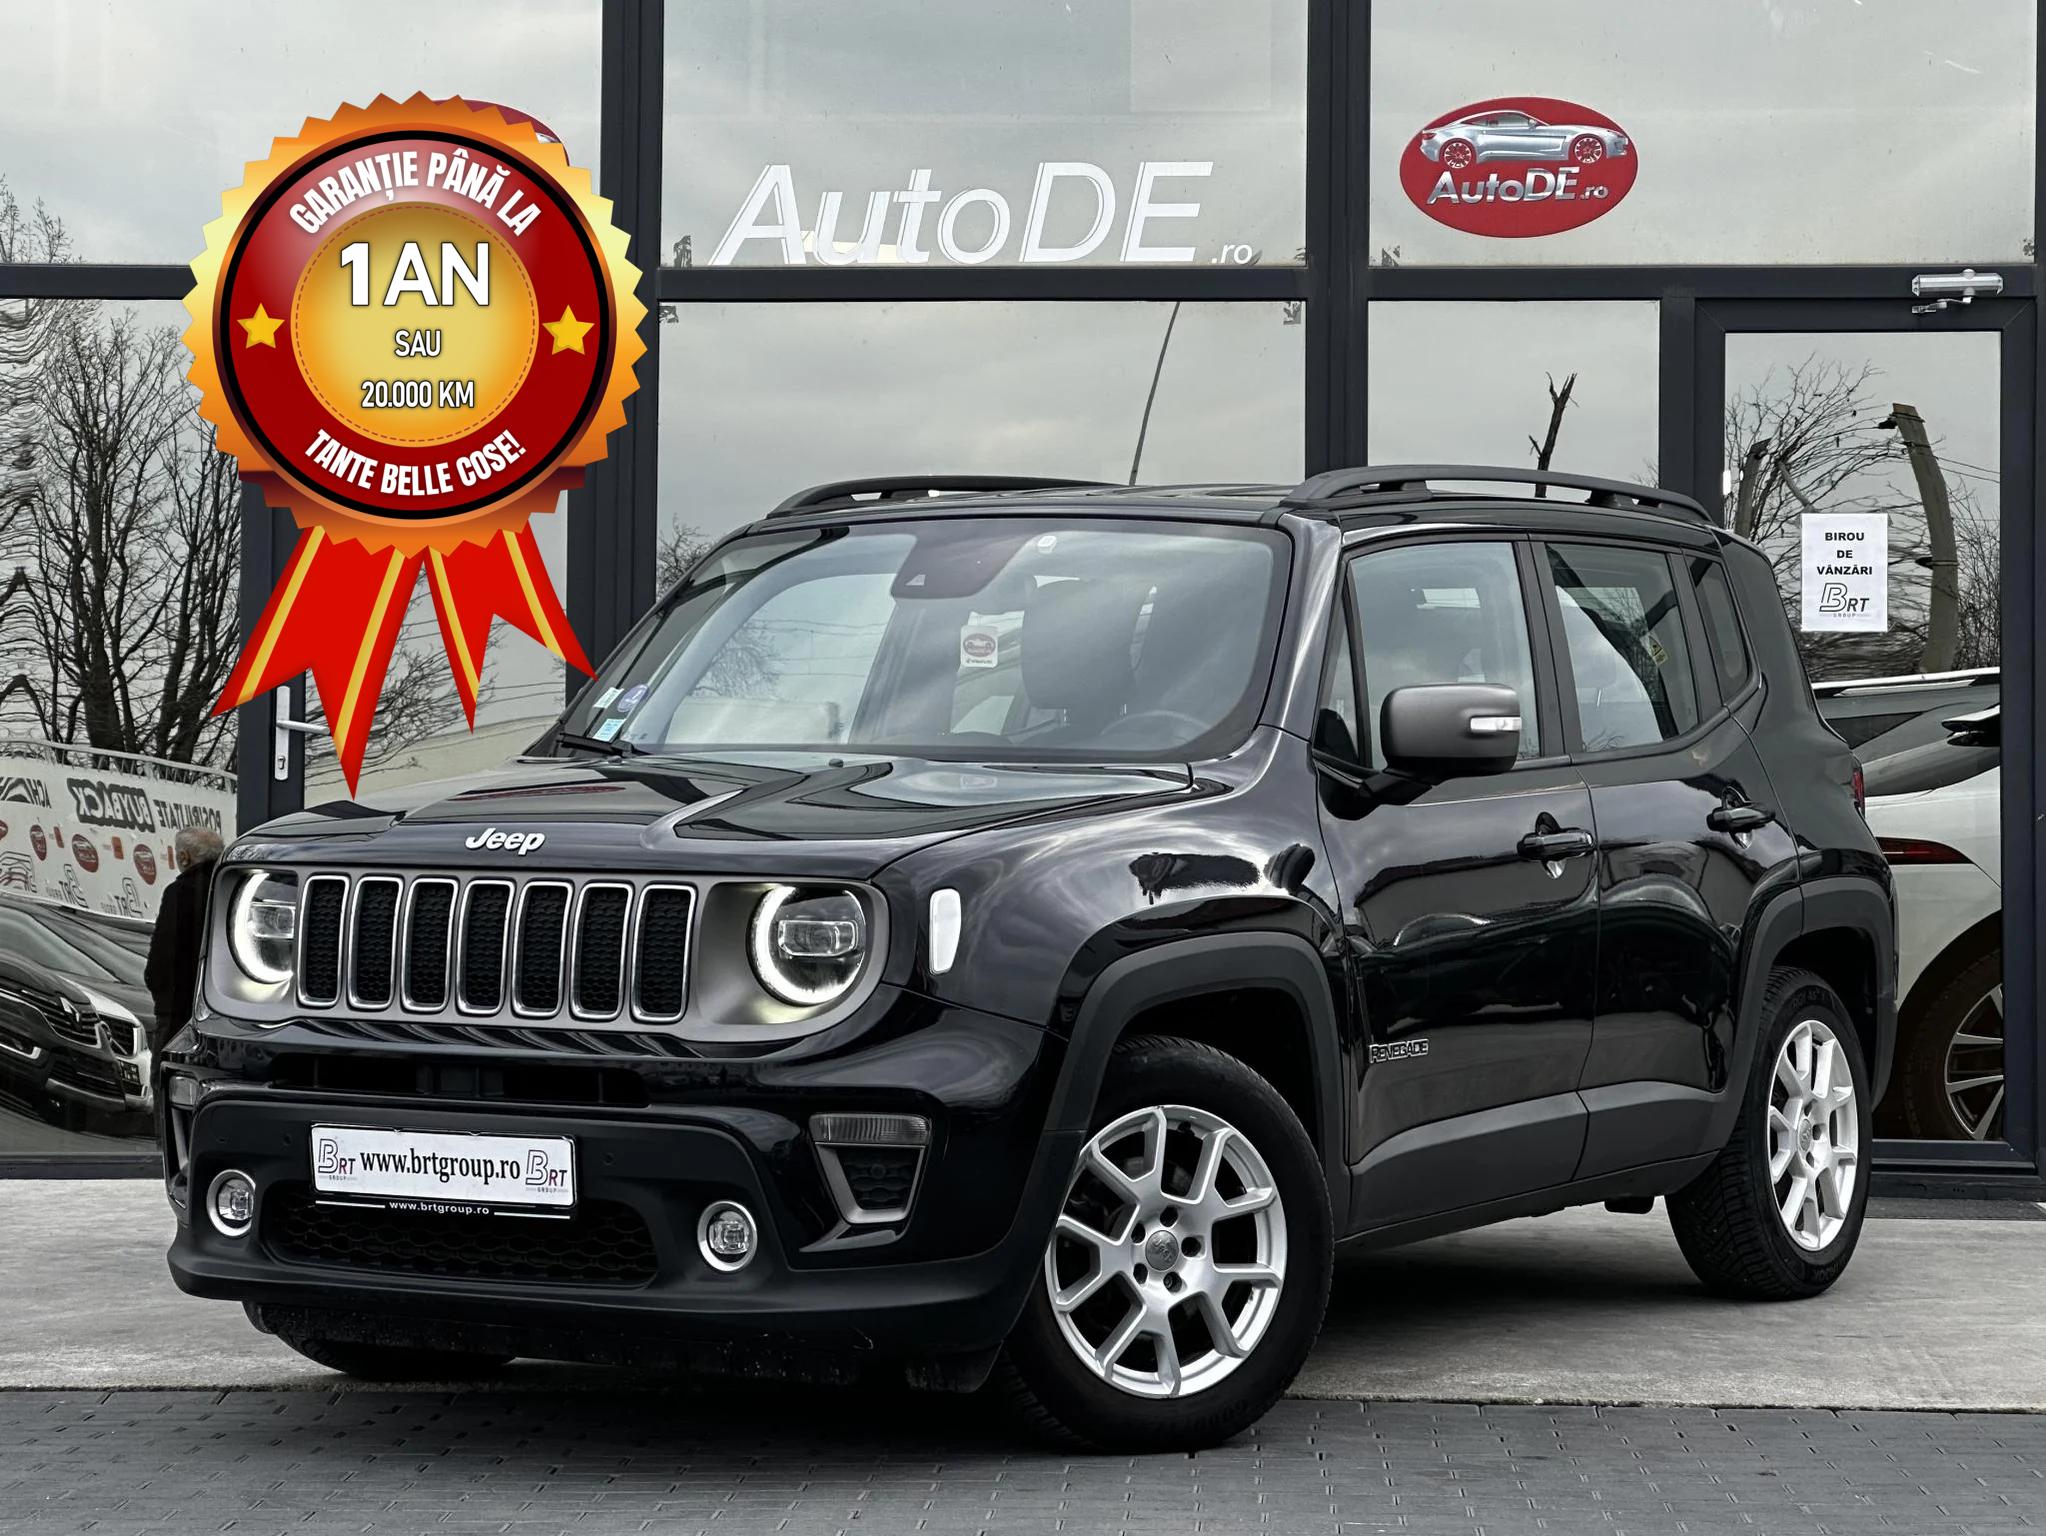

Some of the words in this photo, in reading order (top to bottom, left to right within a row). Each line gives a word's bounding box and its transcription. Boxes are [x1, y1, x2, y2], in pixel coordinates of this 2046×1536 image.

[1825, 532, 1865, 541] BIROU
[1836, 550, 1853, 559] DE
[1816, 564, 1873, 575] VÂNZĂRI
[1819, 582, 1870, 612] BRT
[465, 827, 546, 856] Jeep
[1369, 1038, 1429, 1063] RENEGADE
[318, 1138, 356, 1175] BRT
[360, 1148, 520, 1185] www.brtgroup.ro
[525, 1149, 568, 1187] BRT
[389, 1200, 490, 1215] www.brtgroup.ro
